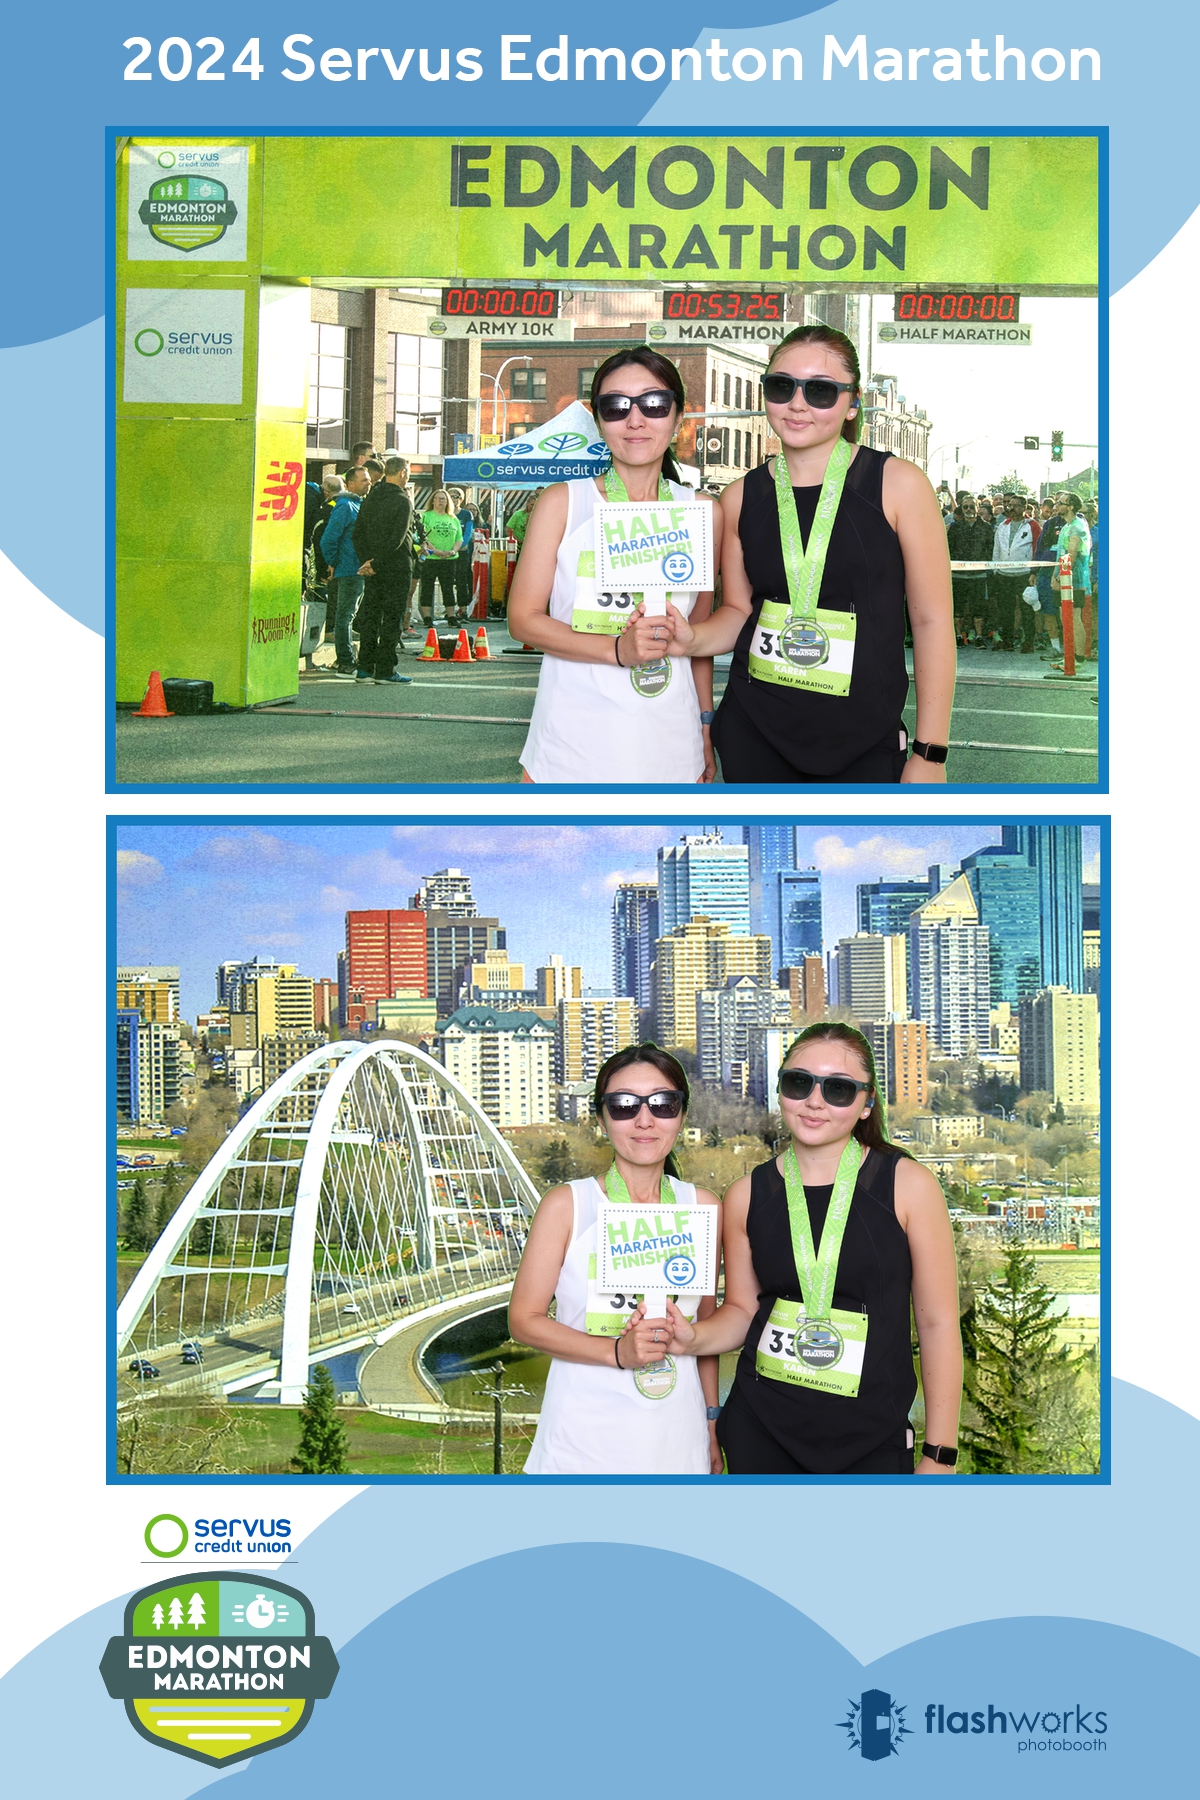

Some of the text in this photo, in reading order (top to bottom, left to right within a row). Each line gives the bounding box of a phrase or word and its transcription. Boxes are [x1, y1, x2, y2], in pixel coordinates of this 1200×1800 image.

[178, 152, 220, 162] servus
[450, 144, 990, 212] EDMONTON
[149, 202, 227, 214] EDMONTON
[160, 214, 215, 223] MARATHON
[523, 222, 906, 272] MARATHON
[465, 321, 555, 336] ARMY 10K
[678, 325, 785, 340] MARATHON
[900, 328, 1031, 341] HALF MARATHON
[168, 331, 233, 345] servus
[168, 345, 233, 355] credit union
[496, 463, 545, 476] servus
[548, 462, 590, 477] credit
[603, 507, 686, 544] HALF
[607, 528, 690, 556] MARATHON
[610, 540, 693, 570] FINISHER!
[257, 613, 291, 643] Running
[773, 663, 808, 677] KAREN
[777, 675, 794, 684] HALF
[794, 678, 834, 691] MARATHON
[606, 1210, 690, 1245] HALF
[610, 1232, 693, 1256] MARATHON
[612, 1244, 695, 1271] FINISHER!
[783, 1362, 817, 1376] KAREN
[786, 1373, 843, 1391] HALF MARATHON
